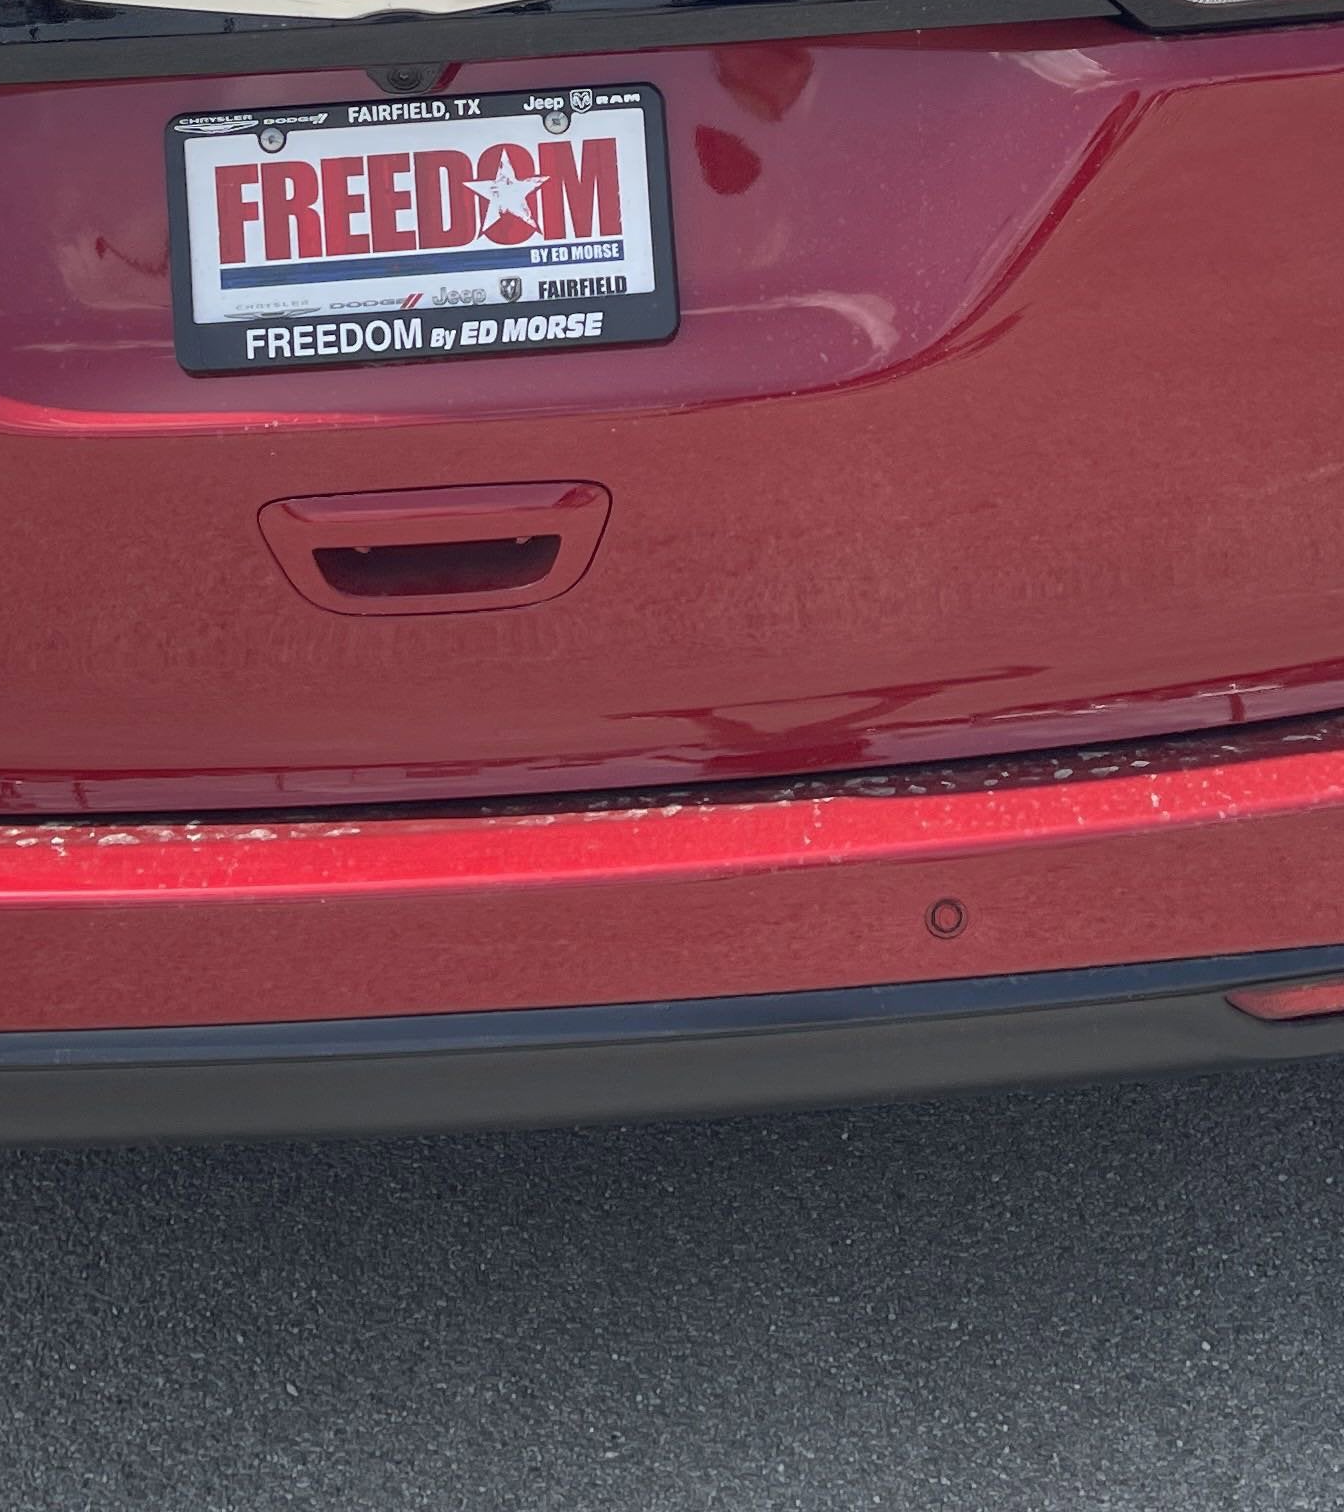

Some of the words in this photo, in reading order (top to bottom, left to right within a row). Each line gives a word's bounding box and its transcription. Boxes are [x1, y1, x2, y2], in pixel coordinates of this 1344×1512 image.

[348, 100, 450, 123] FAIRFIELD,
[454, 98, 481, 116] TX
[523, 95, 564, 111] Jeep
[596, 93, 641, 105] RAM
[179, 114, 253, 126] CHRYSLER
[263, 116, 319, 125] DODGE
[214, 138, 623, 265] FREEDOM
[530, 249, 549, 264] BY
[551, 247, 569, 262] ED
[571, 243, 620, 261] MORSE
[235, 299, 309, 311] CHRYSLER
[329, 297, 406, 309] DODGE
[432, 287, 487, 306] Jeep
[538, 276, 627, 299] FAIRFIELD
[246, 318, 423, 360] FREEDOM
[430, 327, 456, 349] By
[460, 320, 498, 346] ED
[502, 312, 604, 343] MORSE
